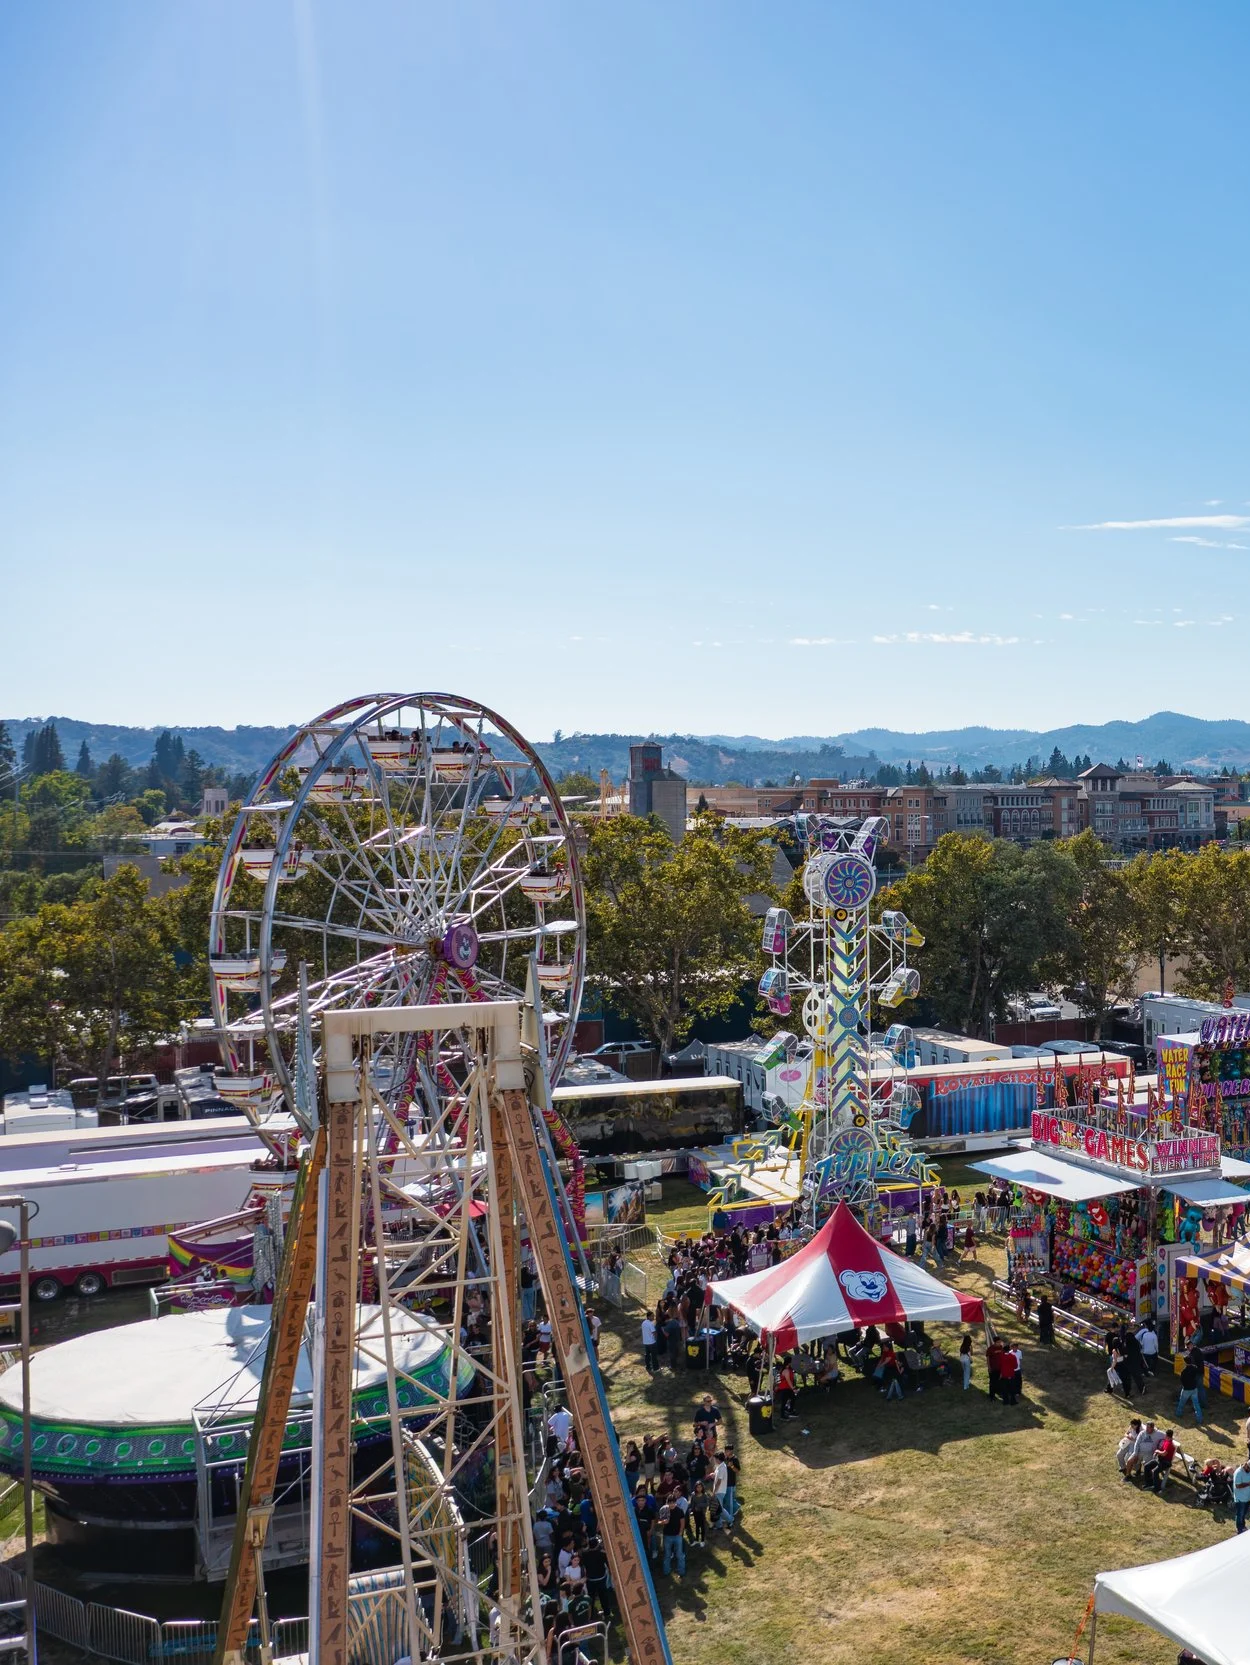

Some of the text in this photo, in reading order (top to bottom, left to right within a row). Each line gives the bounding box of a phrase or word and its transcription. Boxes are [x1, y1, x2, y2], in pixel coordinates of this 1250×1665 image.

[1161, 1047, 1189, 1063] WATER
[1165, 1062, 1187, 1077] RACE
[933, 1076, 995, 1097] ROYAL
[999, 1071, 1056, 1086] CIRCU
[1169, 1079, 1186, 1093] FUN
[204, 1105, 241, 1113] PINNACL
[1031, 1111, 1149, 1172] BIG GAMES
[1156, 1137, 1217, 1157] WINNER
[1153, 1151, 1220, 1173] EVERY TIME
[815, 1149, 926, 1201] Zipper
